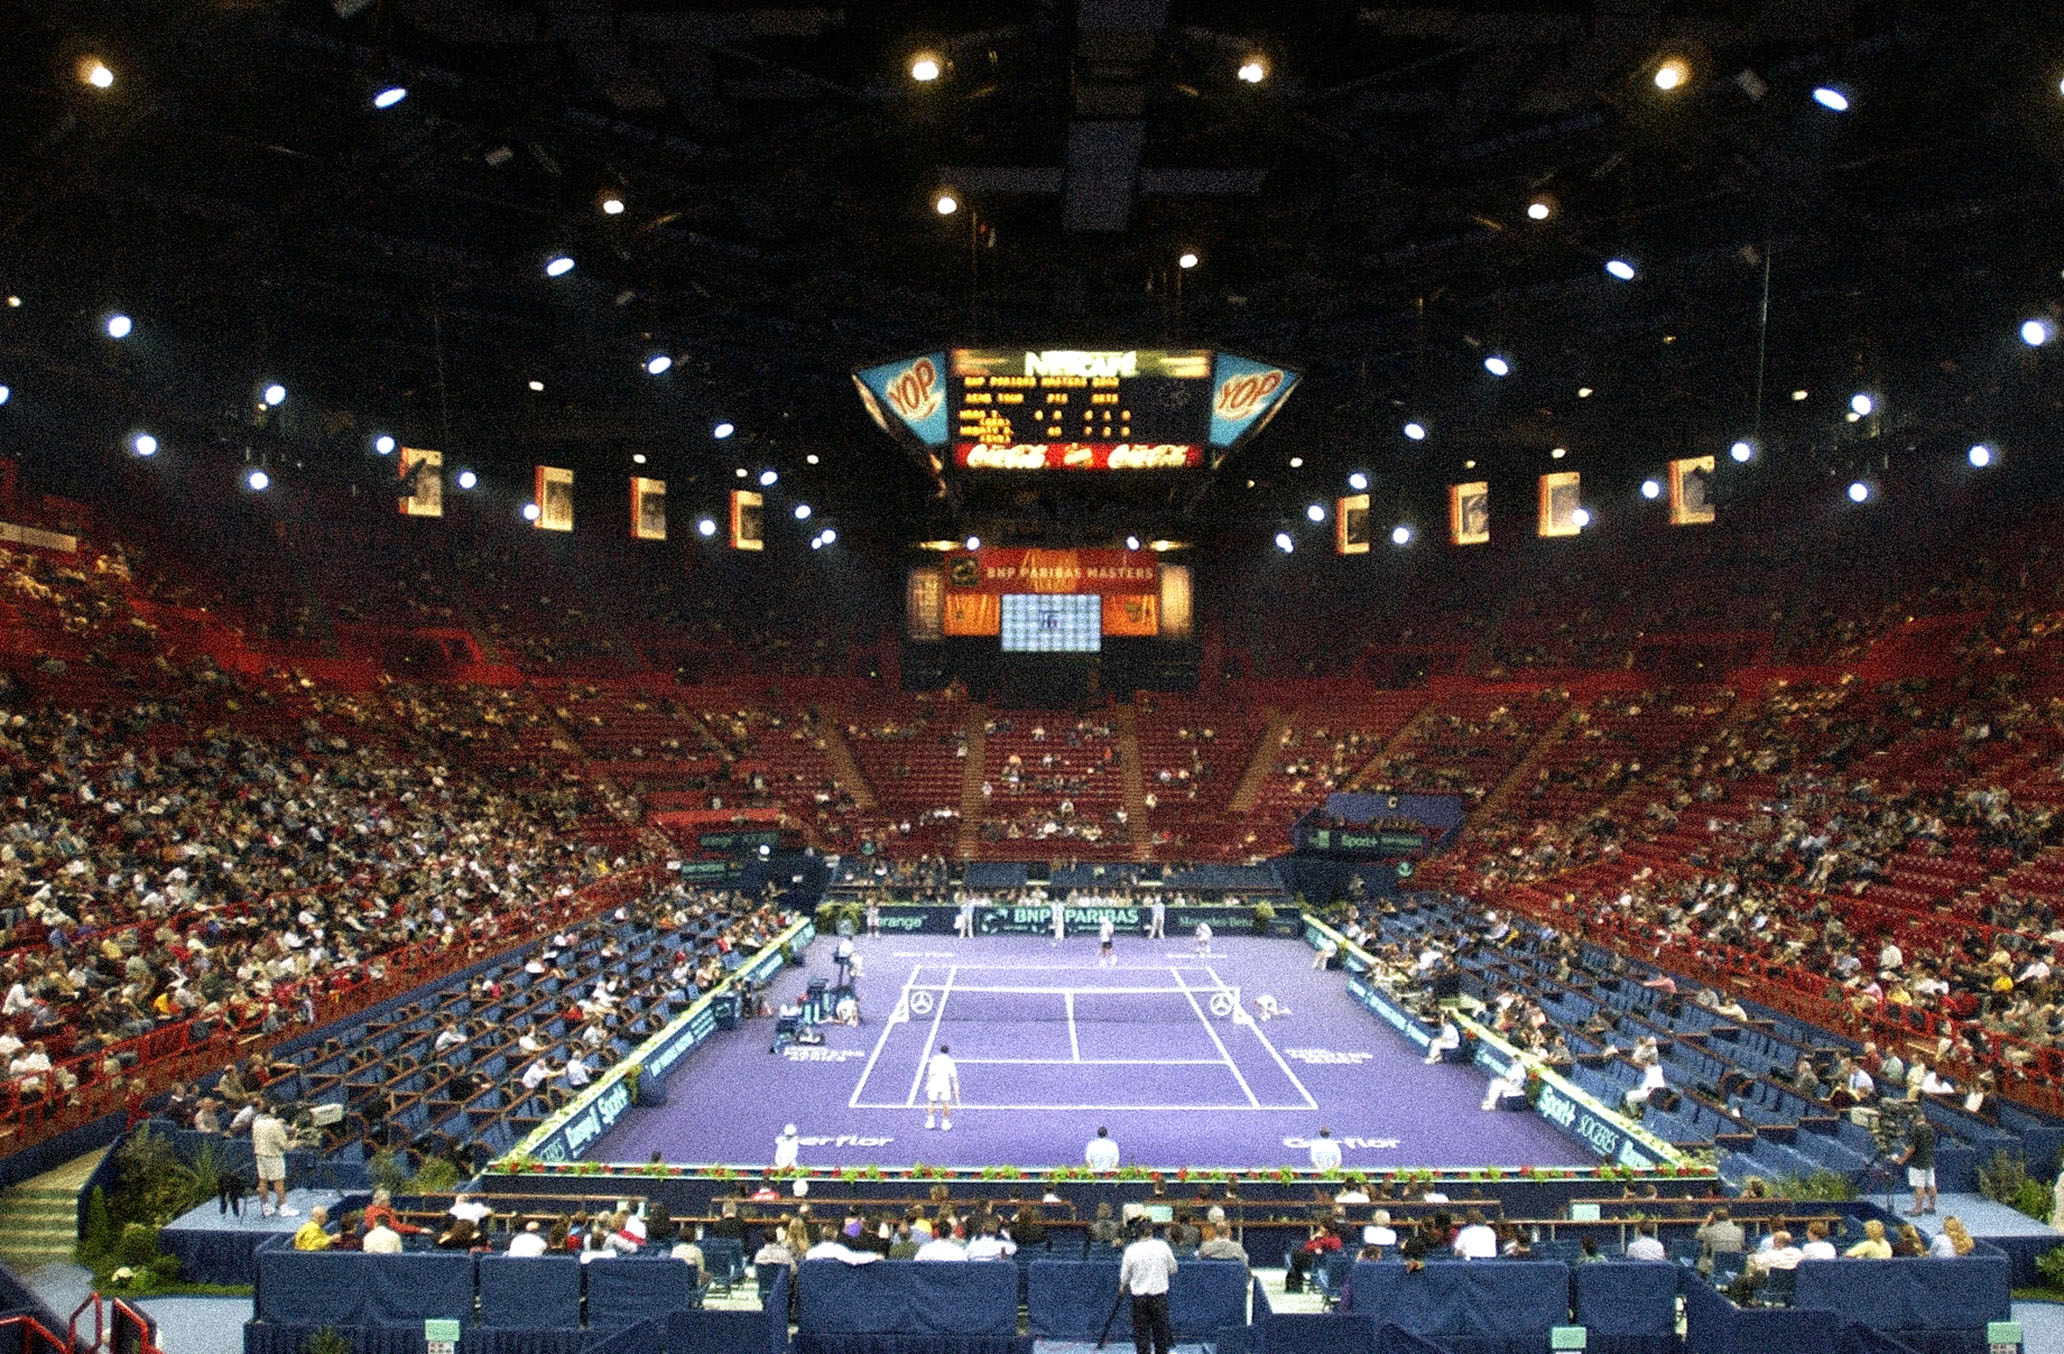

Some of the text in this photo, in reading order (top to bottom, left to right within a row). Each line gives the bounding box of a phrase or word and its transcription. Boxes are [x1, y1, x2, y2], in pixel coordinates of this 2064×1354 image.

[888, 360, 935, 415] YOP
[1218, 372, 1282, 409] YOP
[986, 567, 1154, 579] BNP PARIBAS MASTERS
[1013, 908, 1139, 924] BNP PARIBAS
[798, 1135, 895, 1147] erflor
